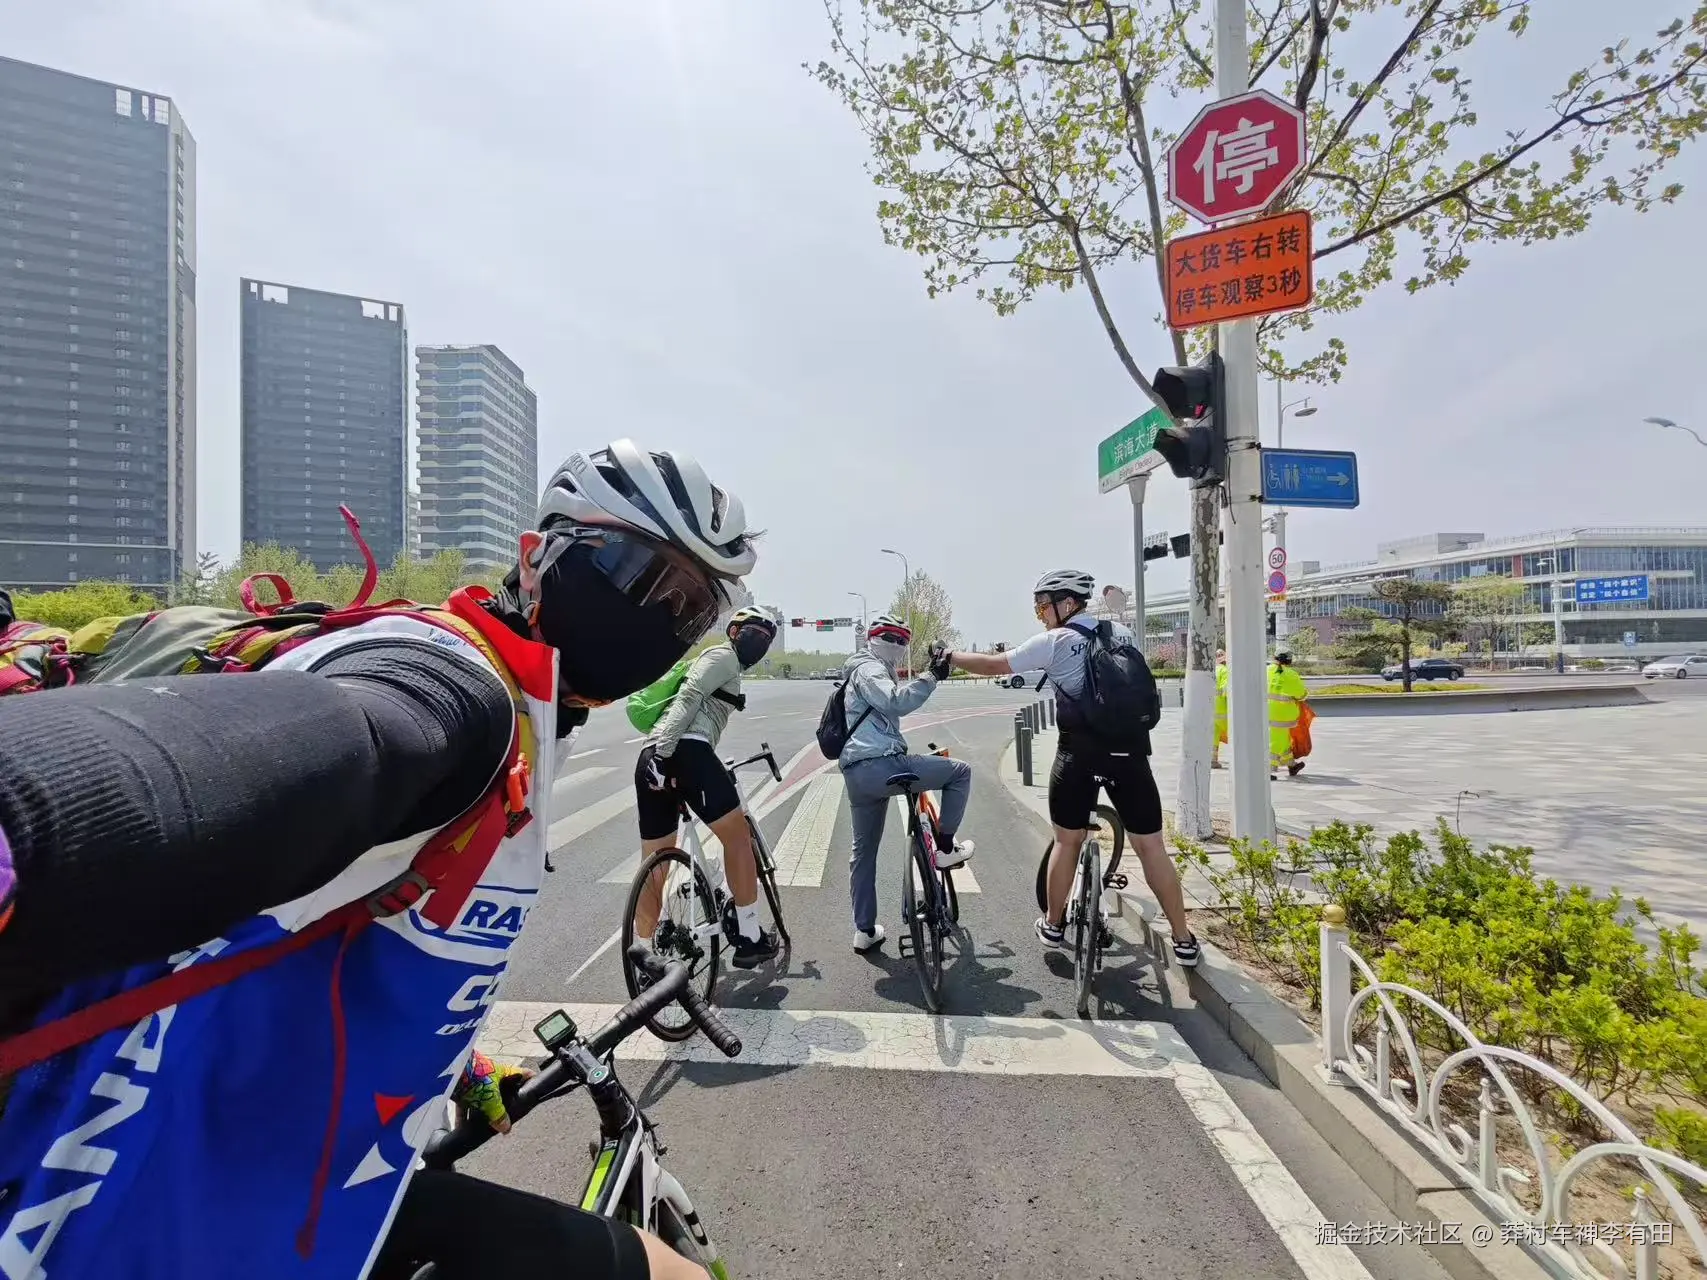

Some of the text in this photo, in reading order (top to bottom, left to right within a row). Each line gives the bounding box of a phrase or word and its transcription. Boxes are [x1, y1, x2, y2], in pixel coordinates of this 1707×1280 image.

[1193, 117, 1279, 204] 停
[1176, 226, 1302, 277] 大货车右转
[1176, 268, 1302, 316] 停车观察3秒
[1272, 553, 1283, 564] 50
